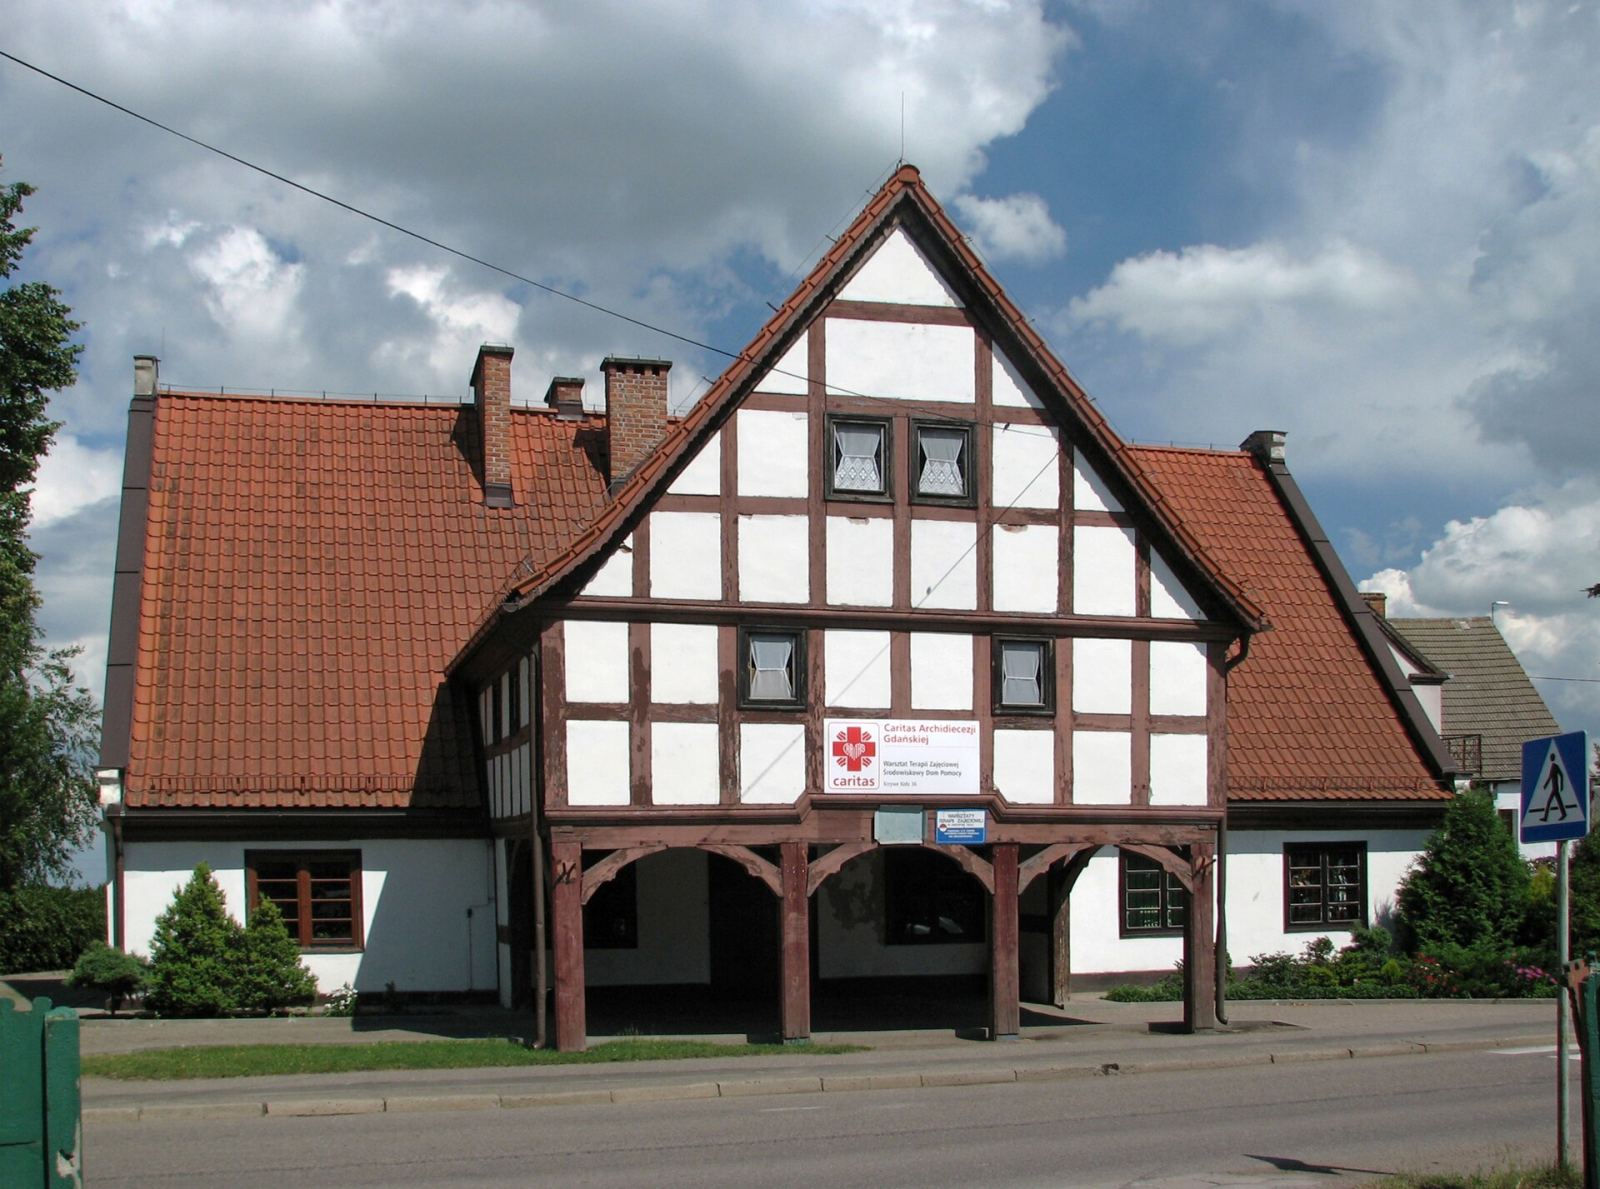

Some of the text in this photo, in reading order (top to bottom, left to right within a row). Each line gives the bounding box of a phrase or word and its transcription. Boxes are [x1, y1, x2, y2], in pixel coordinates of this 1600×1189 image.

[884, 724, 976, 735] Caritas Archidiecezji
[883, 734, 929, 745] Gdańskiej
[833, 775, 875, 786] caritas
